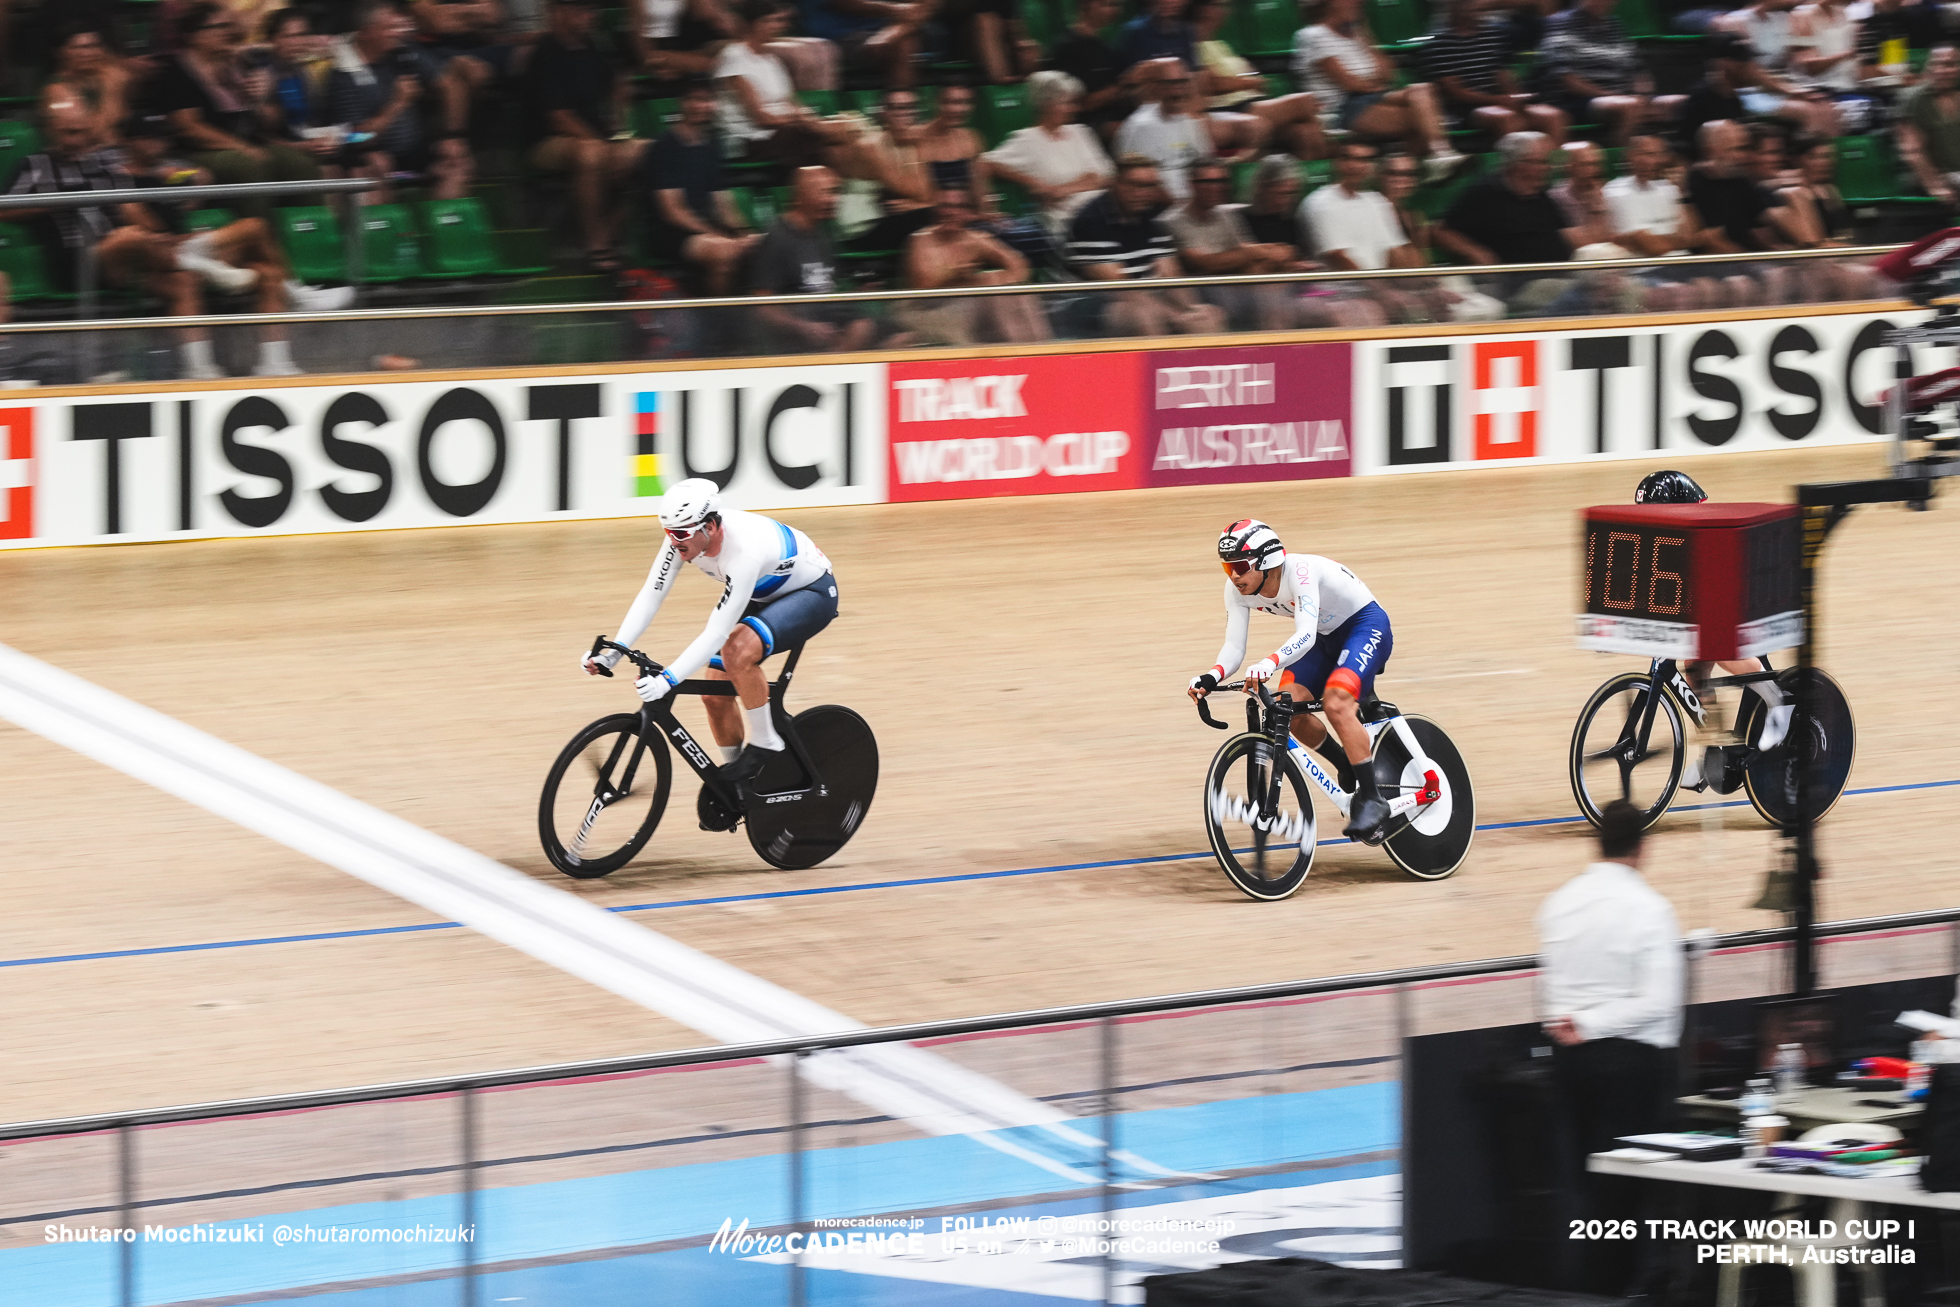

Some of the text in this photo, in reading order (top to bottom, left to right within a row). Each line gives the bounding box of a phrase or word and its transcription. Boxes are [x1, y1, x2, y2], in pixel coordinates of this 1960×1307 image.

[893, 374, 1029, 423] TRACK
[1155, 362, 1276, 410] PERTH
[1567, 313, 1915, 455] TISSO
[66, 382, 607, 535] TISSOT
[678, 382, 860, 490] UCI
[893, 430, 1131, 484] WORLD CUP
[1152, 419, 1350, 471] AUSTRALIA
[1585, 531, 1685, 615] 106
[1354, 628, 1383, 673] JAPAN
[671, 727, 711, 769] FES
